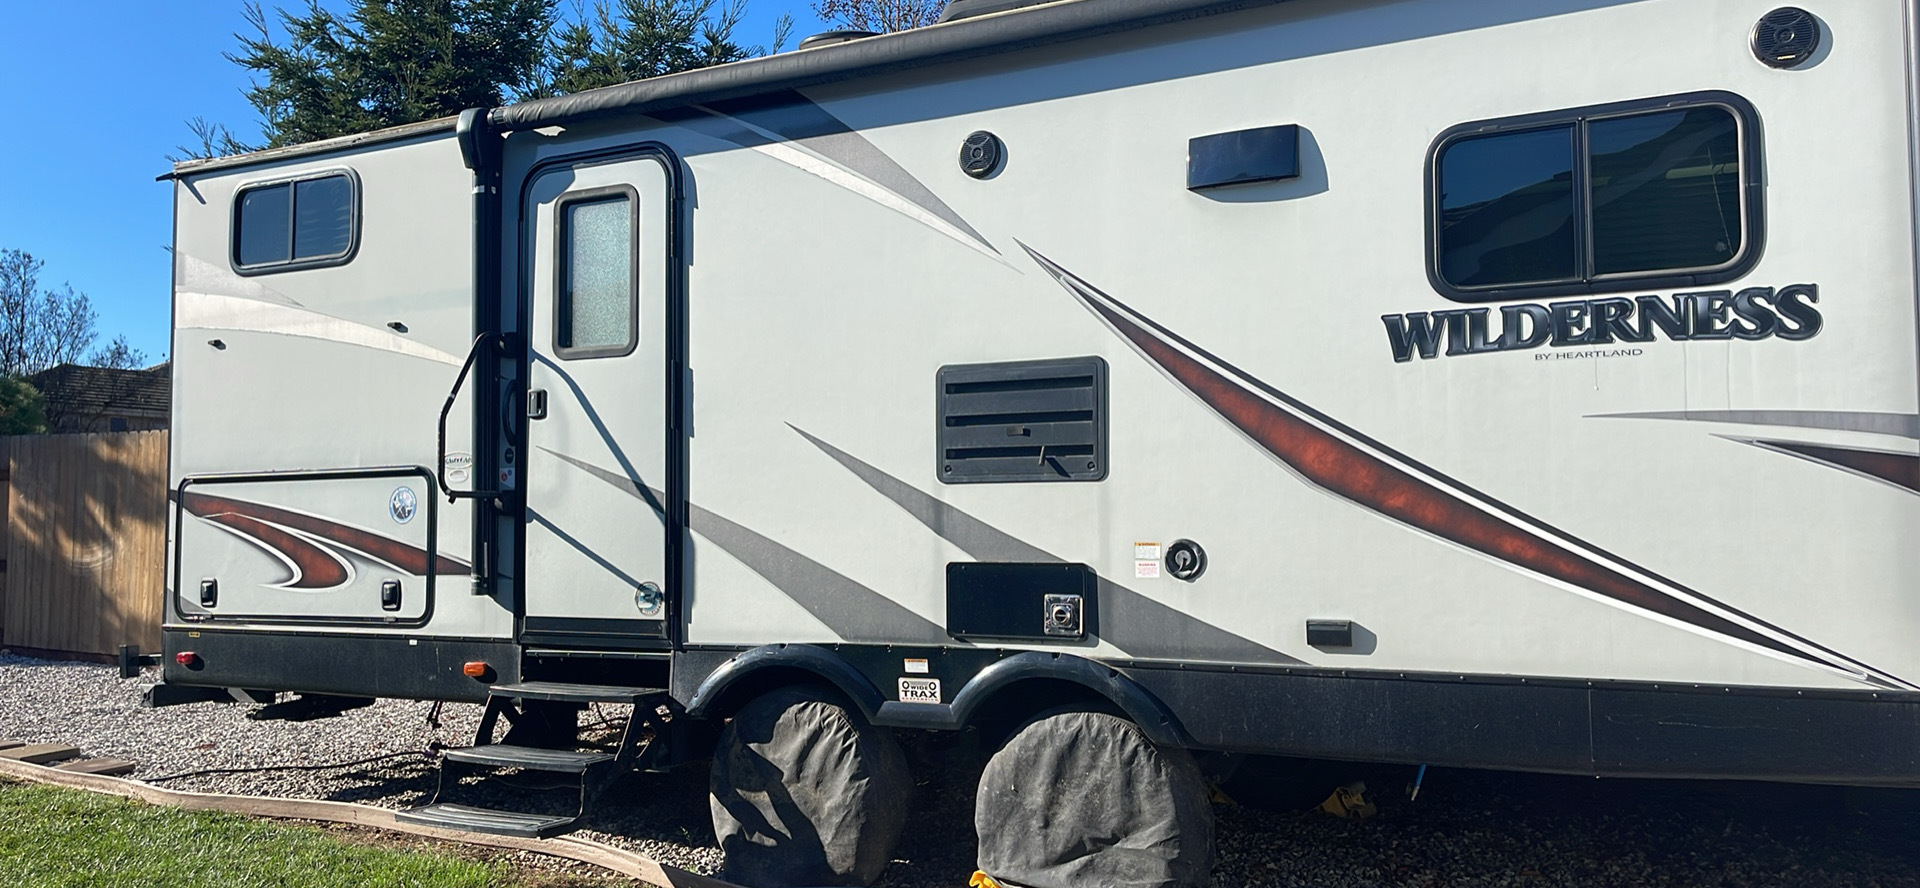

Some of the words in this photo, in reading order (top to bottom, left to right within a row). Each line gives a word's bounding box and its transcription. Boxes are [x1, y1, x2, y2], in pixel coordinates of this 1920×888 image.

[1381, 284, 1824, 363] WILDERNESS
[1535, 353, 1551, 361] BY
[1556, 348, 1643, 360] HEARTLAND
[901, 690, 938, 698] TRAX
